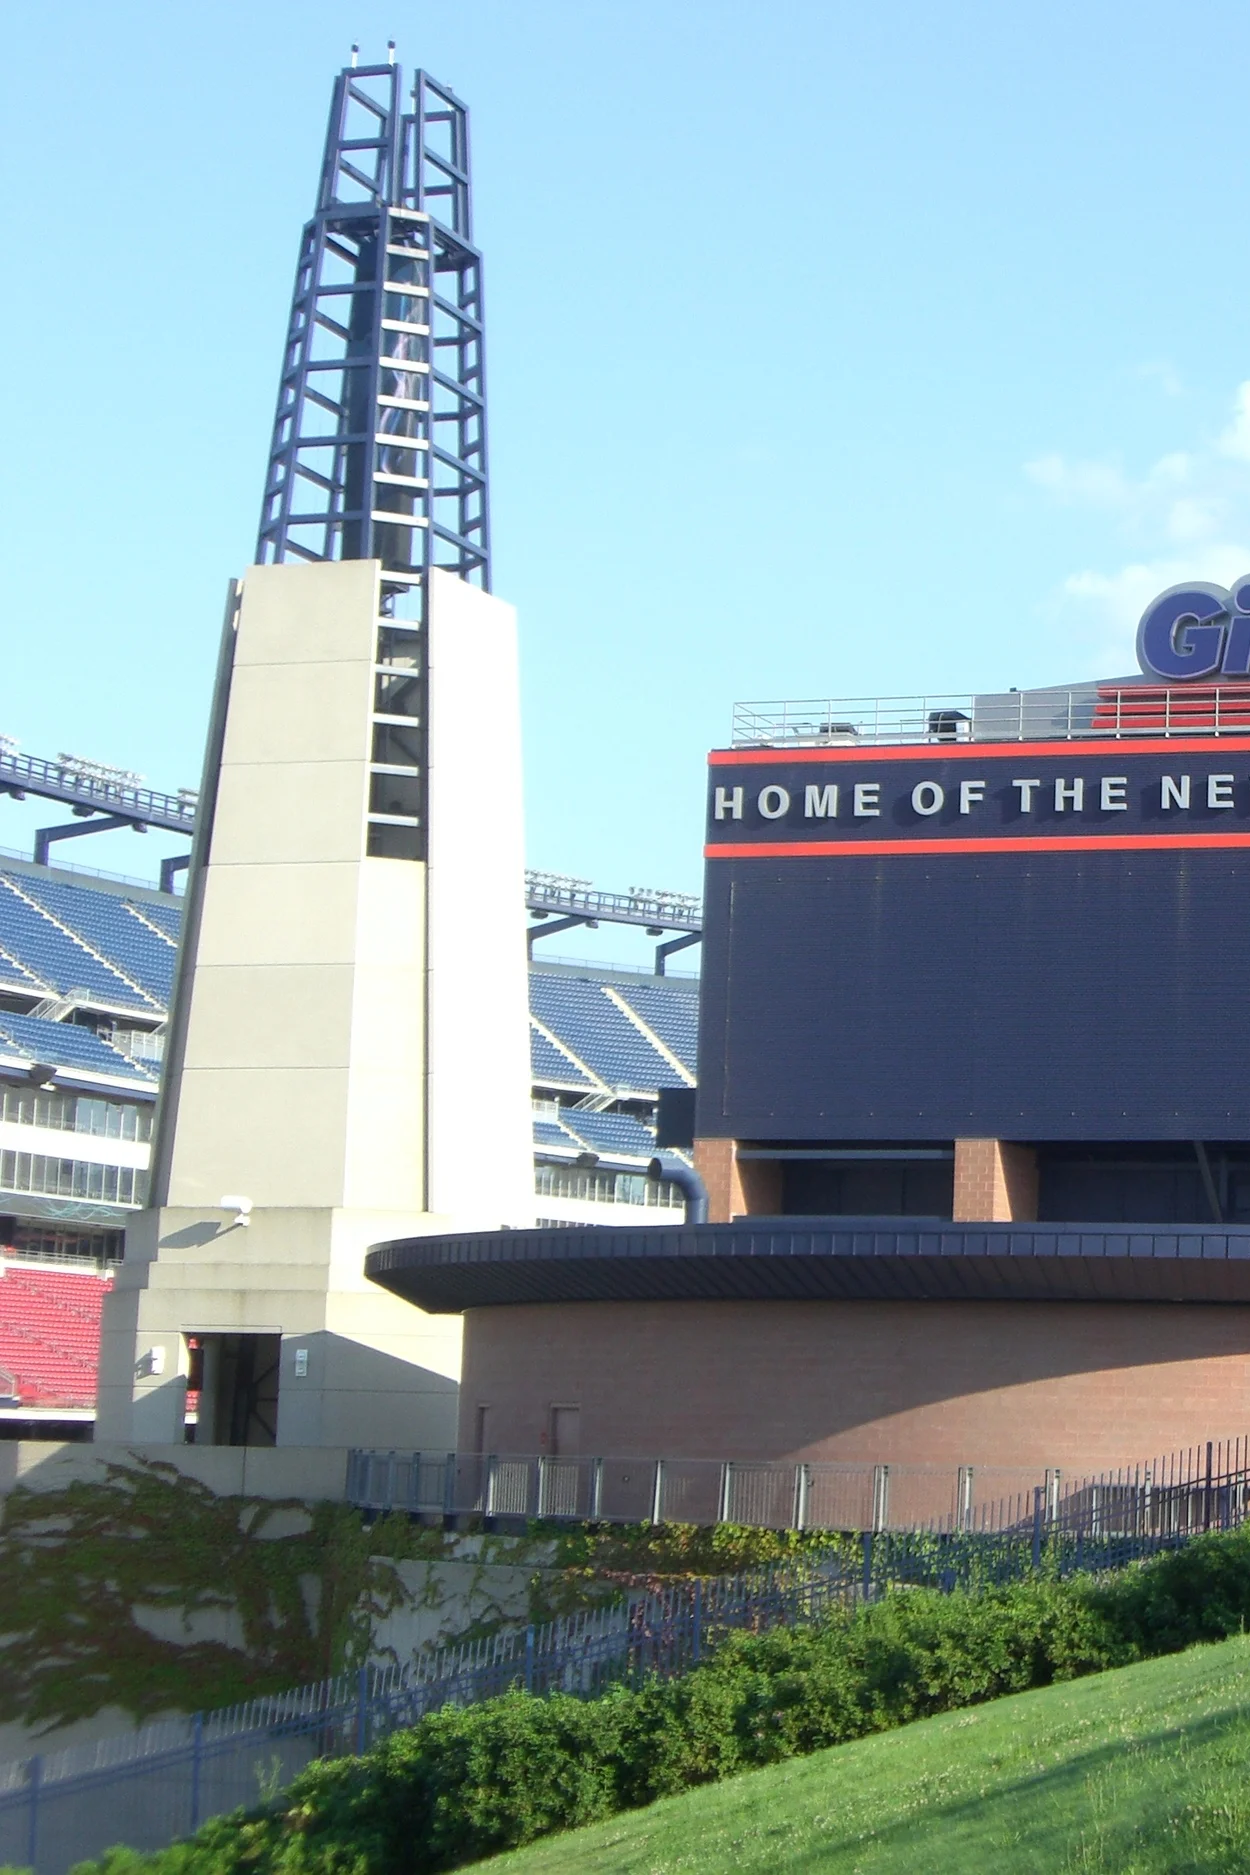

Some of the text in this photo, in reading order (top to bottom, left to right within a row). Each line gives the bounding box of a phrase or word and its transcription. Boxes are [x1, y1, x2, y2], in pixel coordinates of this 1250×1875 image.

[714, 783, 881, 820] HOME
[911, 780, 986, 816] OF
[1012, 777, 1128, 813] THE
